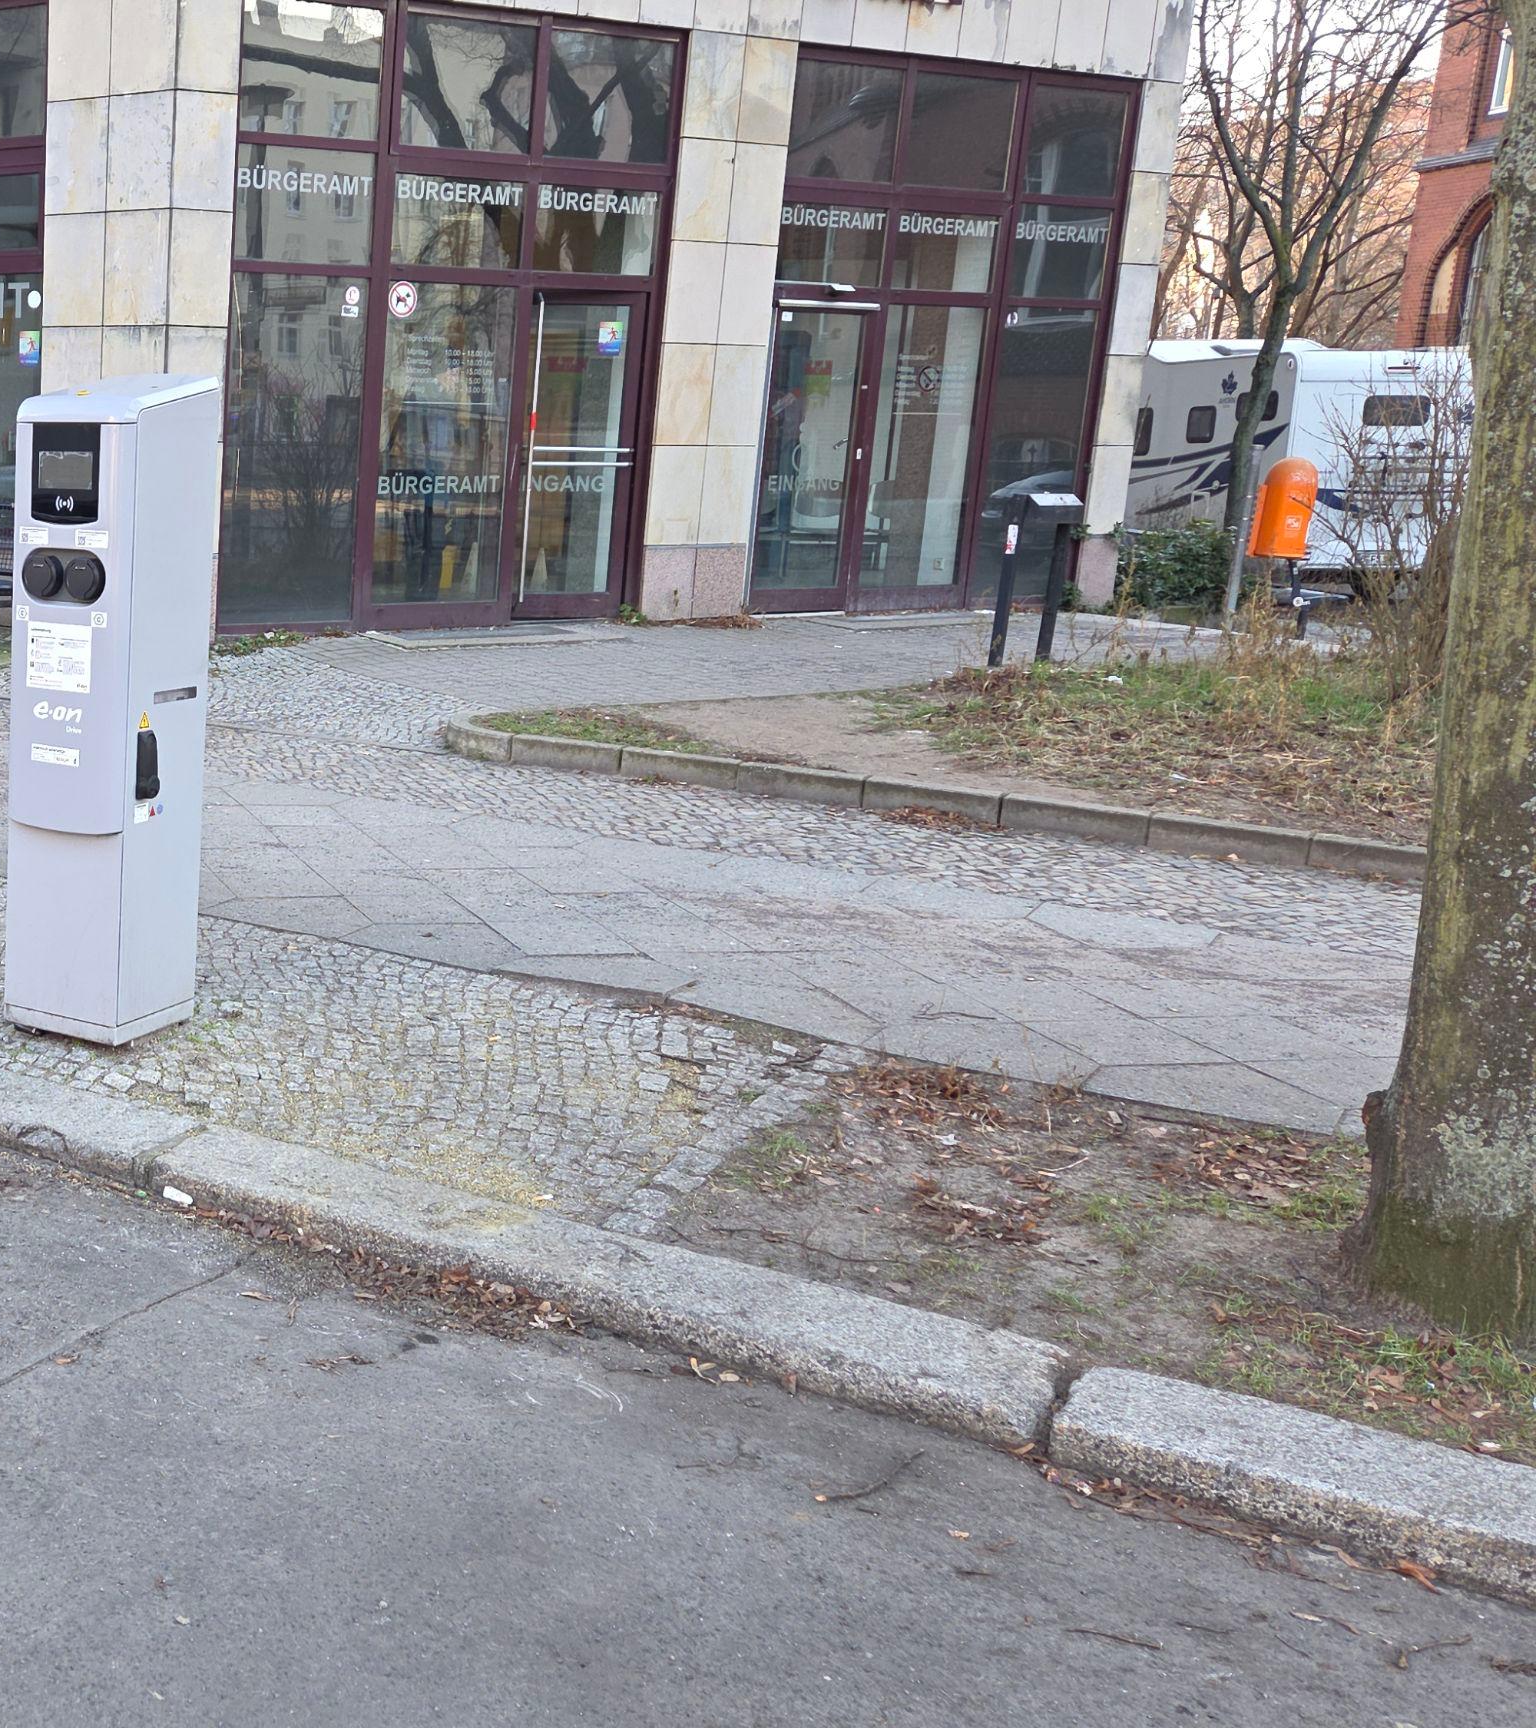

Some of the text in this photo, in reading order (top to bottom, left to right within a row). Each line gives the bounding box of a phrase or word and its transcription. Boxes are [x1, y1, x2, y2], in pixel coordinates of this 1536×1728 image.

[237, 165, 373, 197] BÜRGERAMT
[397, 177, 523, 207] BÜRGERAMT
[540, 187, 658, 216] BÜRGERAMT
[781, 203, 886, 231] BÜRGERAMT
[899, 212, 999, 238] BÜRGERAMT
[1015, 219, 1109, 244] BÜRGERAMT
[377, 472, 500, 495] BÜRGERAMT
[518, 474, 606, 493] INGANG
[768, 474, 840, 493] EINGANG
[66, 725, 82, 735] Drive
